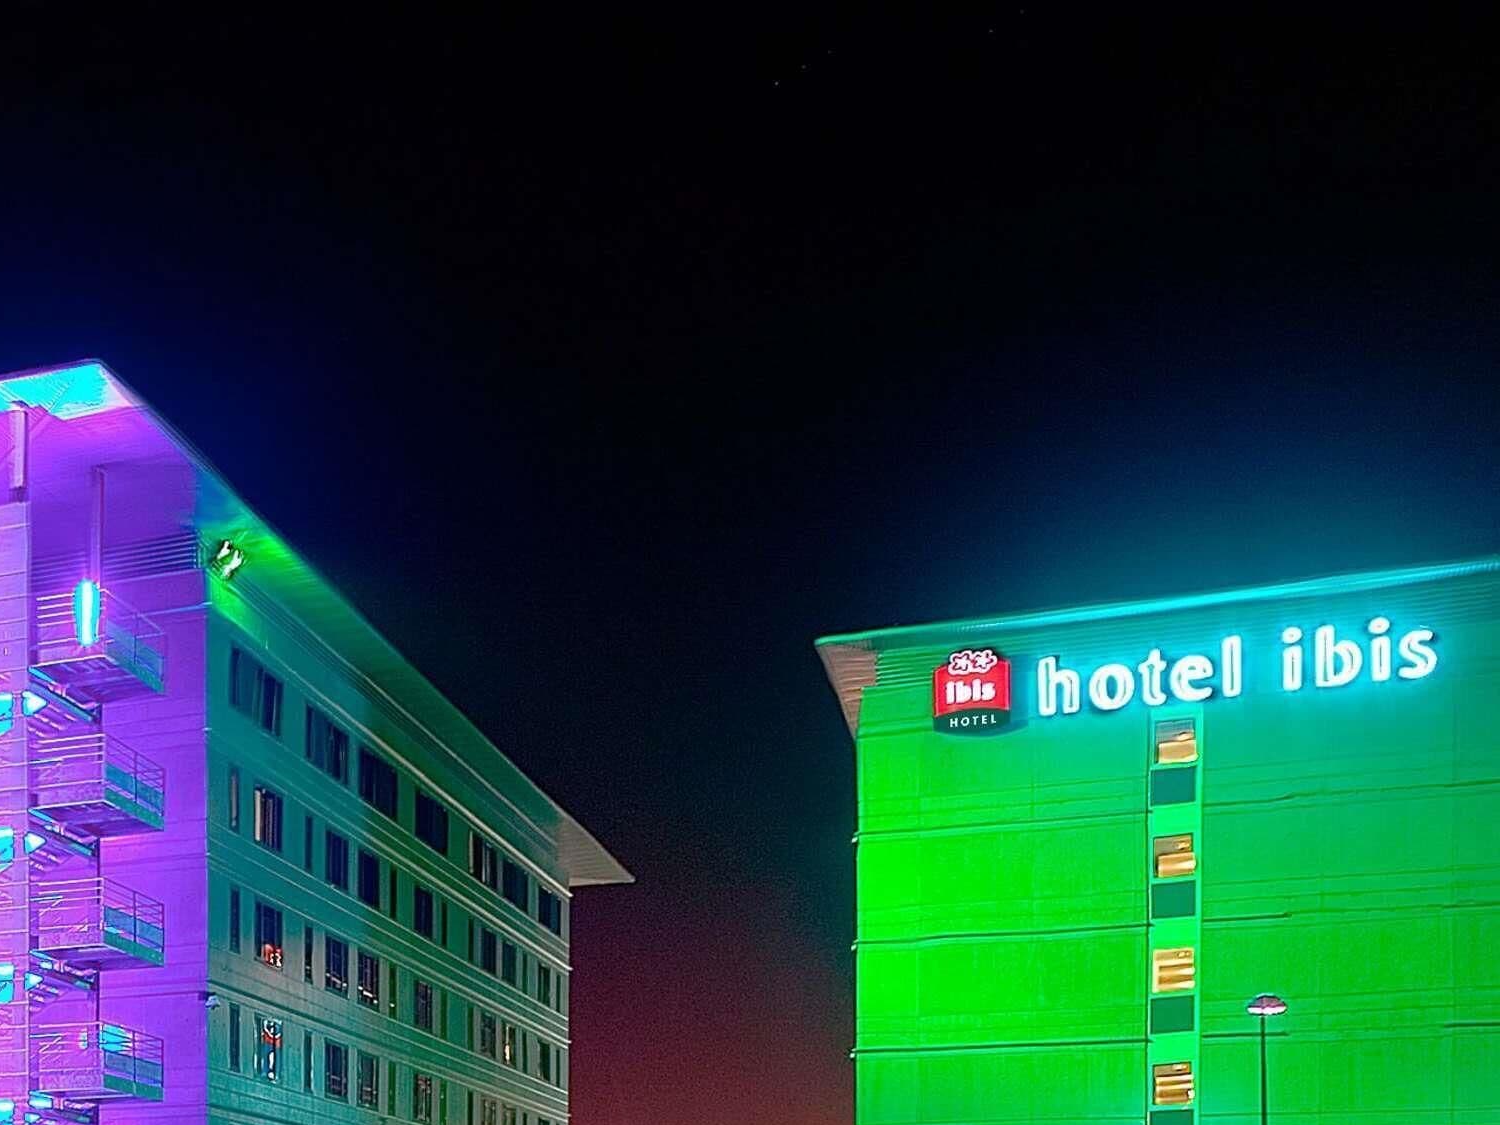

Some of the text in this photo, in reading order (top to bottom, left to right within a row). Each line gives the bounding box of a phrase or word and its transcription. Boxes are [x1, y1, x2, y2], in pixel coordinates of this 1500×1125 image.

[1038, 617, 1438, 716] hotel ibis
[946, 679, 996, 705] ibis
[949, 714, 997, 728] HOTEL
